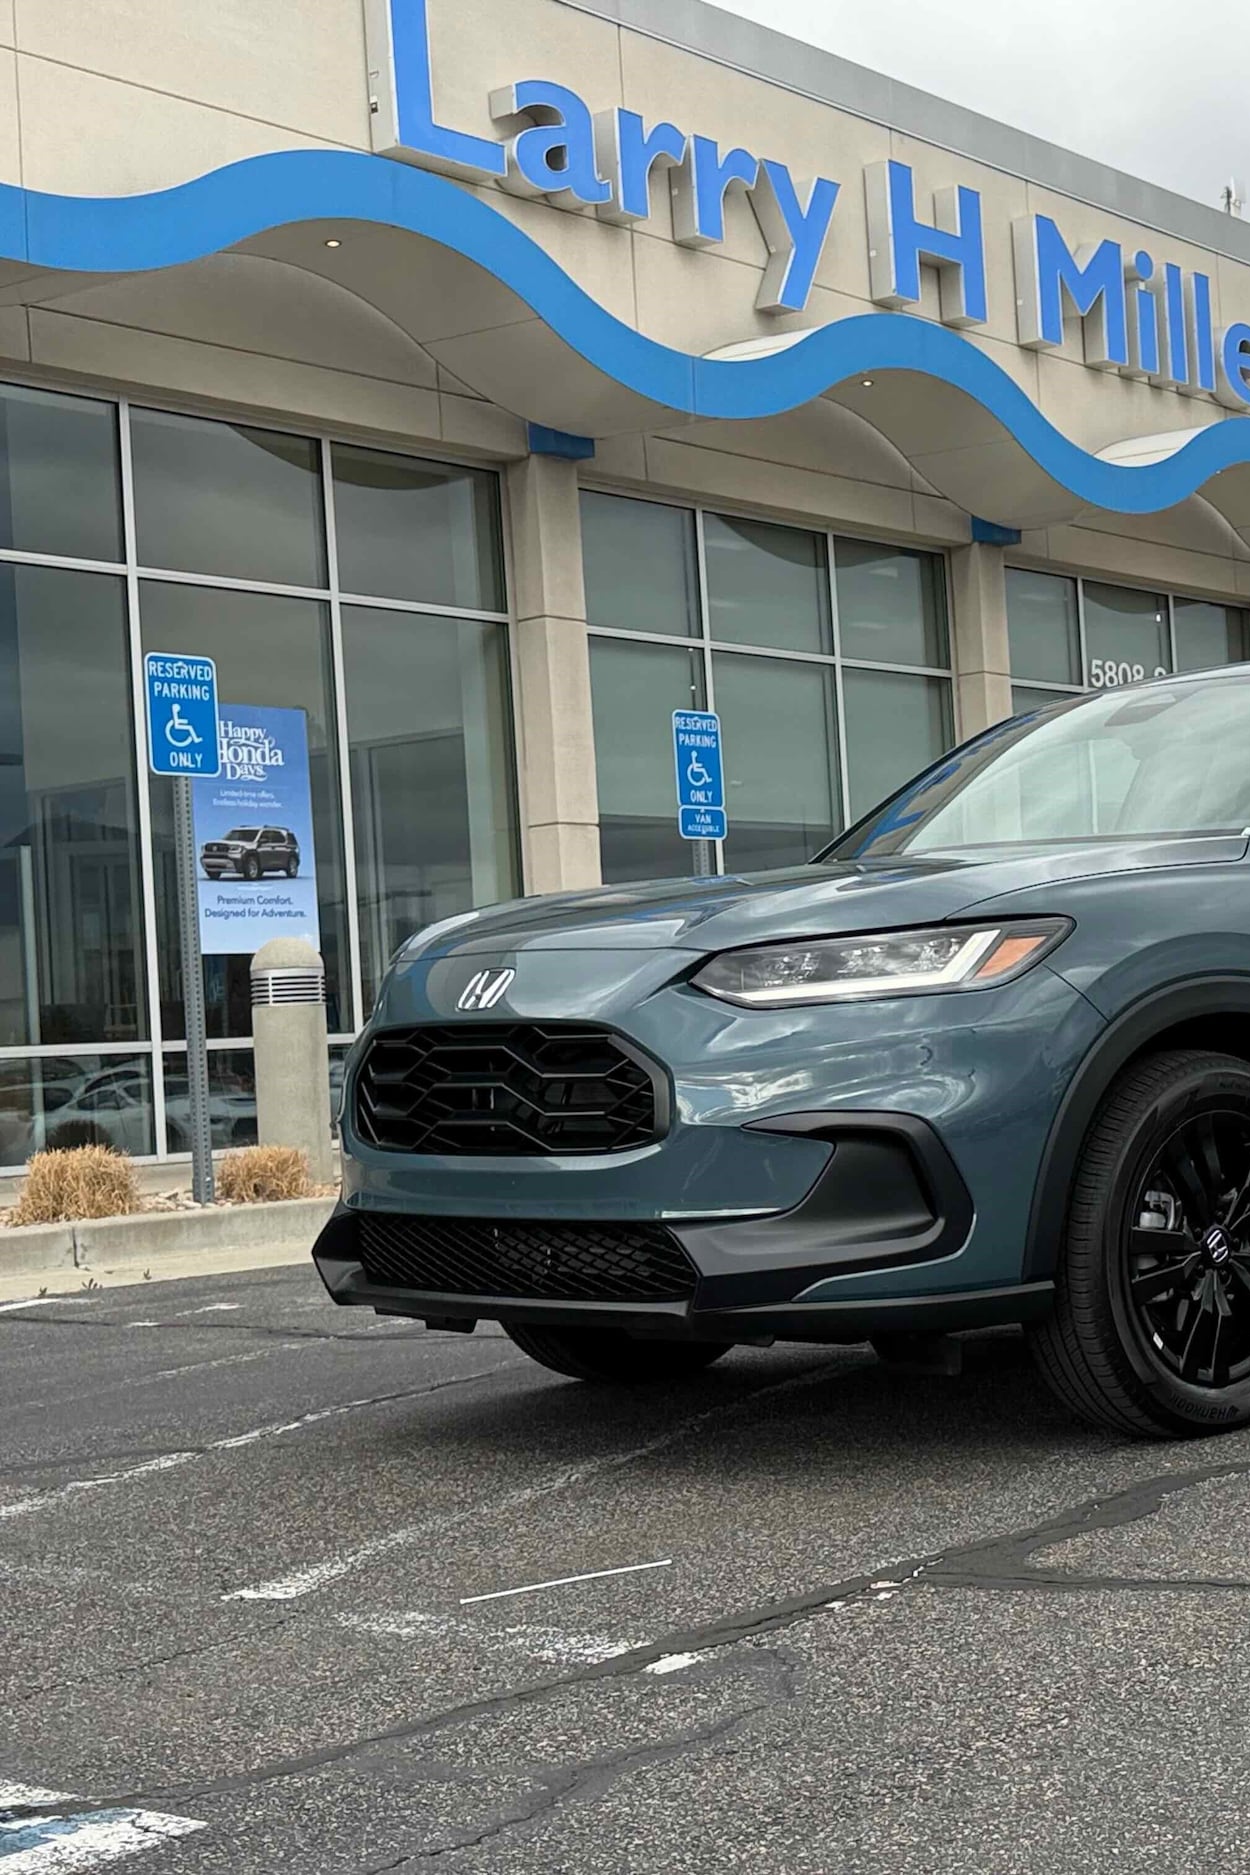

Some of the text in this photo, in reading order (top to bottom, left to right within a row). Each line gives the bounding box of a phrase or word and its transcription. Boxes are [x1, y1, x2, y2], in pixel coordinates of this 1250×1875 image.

[388, 0, 841, 313] Larry
[886, 159, 986, 325] H
[148, 660, 212, 681] RESERVED
[1091, 659, 1145, 688] 5808
[154, 681, 210, 701] PARKING
[220, 720, 267, 743] Happy
[675, 716, 717, 732] RESERVED
[678, 733, 717, 748] PARKING
[169, 751, 203, 768] ONLY
[690, 790, 713, 803] ONLY
[695, 814, 712, 824] VAN
[217, 895, 293, 905] Premium Comfort.
[204, 908, 307, 920] Designed for Adventure.
